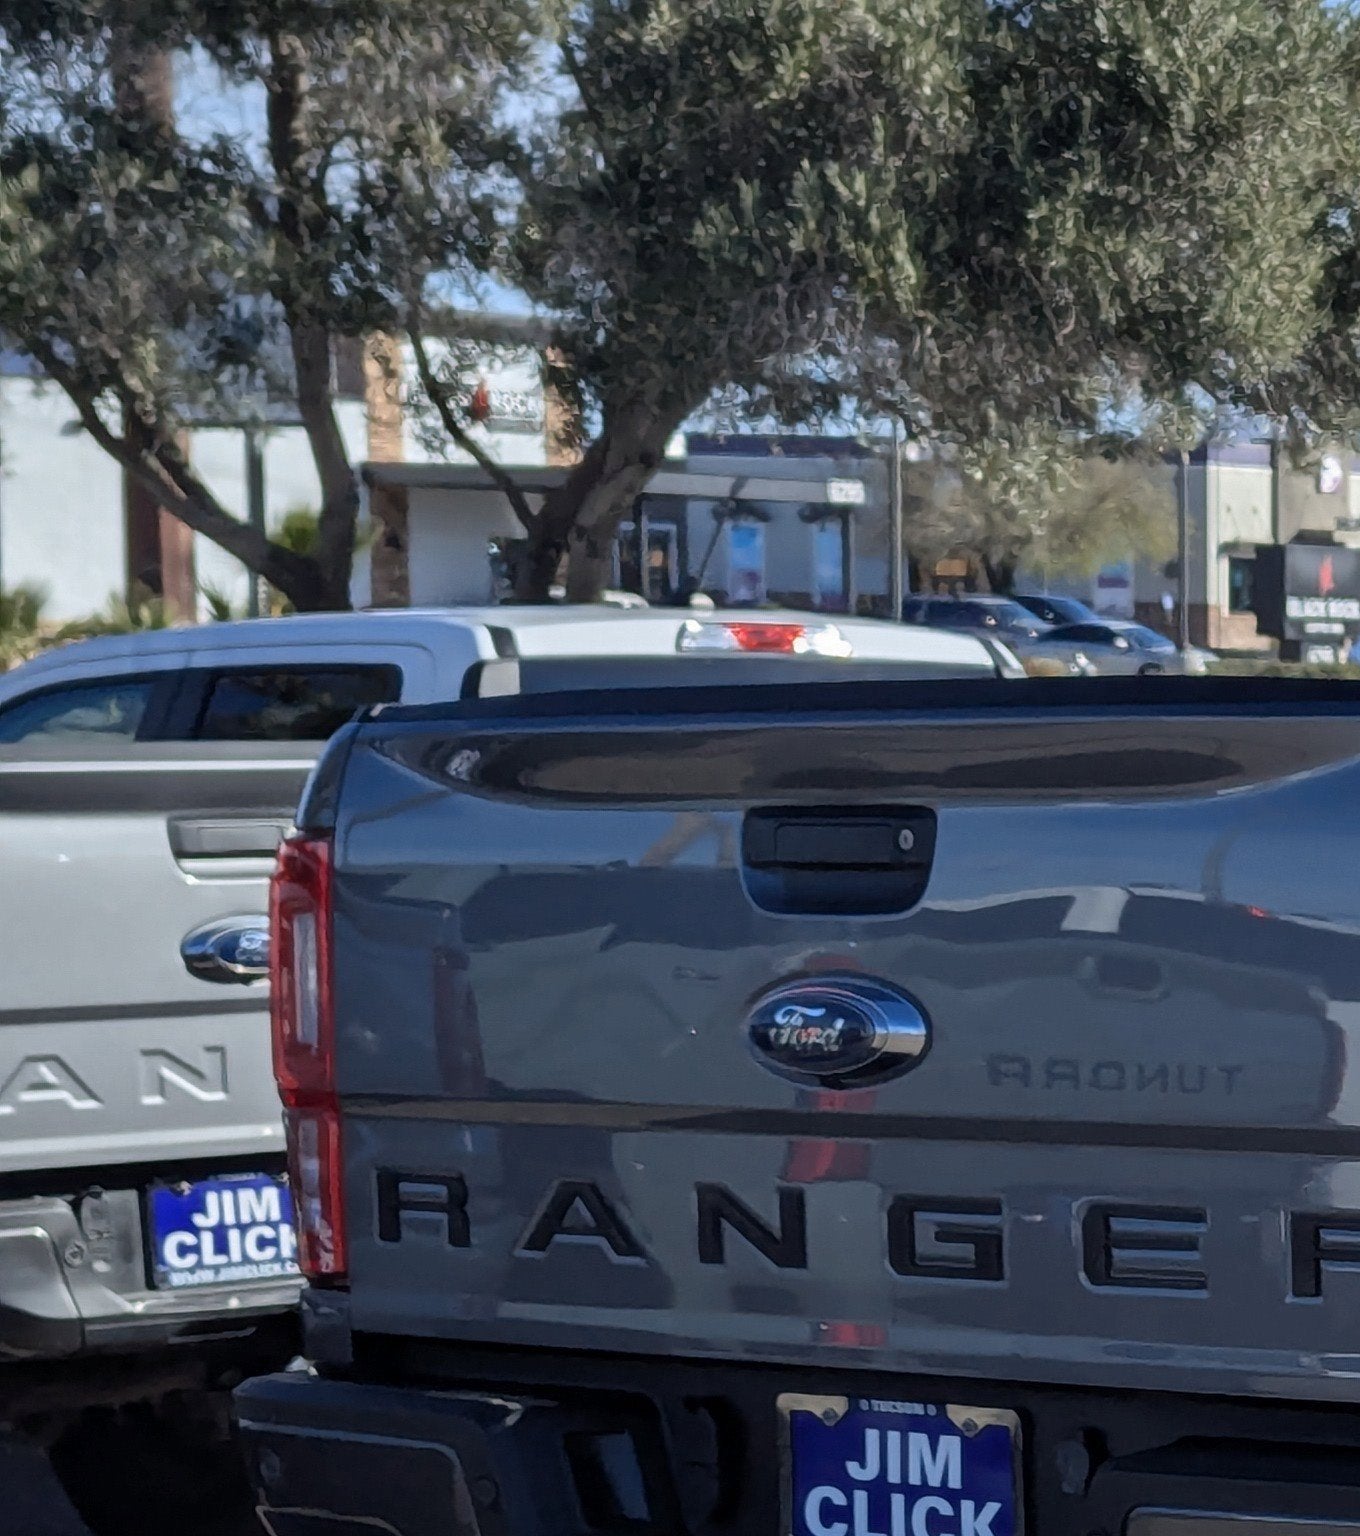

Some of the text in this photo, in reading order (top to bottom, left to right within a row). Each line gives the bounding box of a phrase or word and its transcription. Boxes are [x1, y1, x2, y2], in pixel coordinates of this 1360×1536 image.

[768, 1005, 845, 1052] Ford
[191, 1186, 281, 1228] JIM
[845, 1428, 962, 1489] JIM
